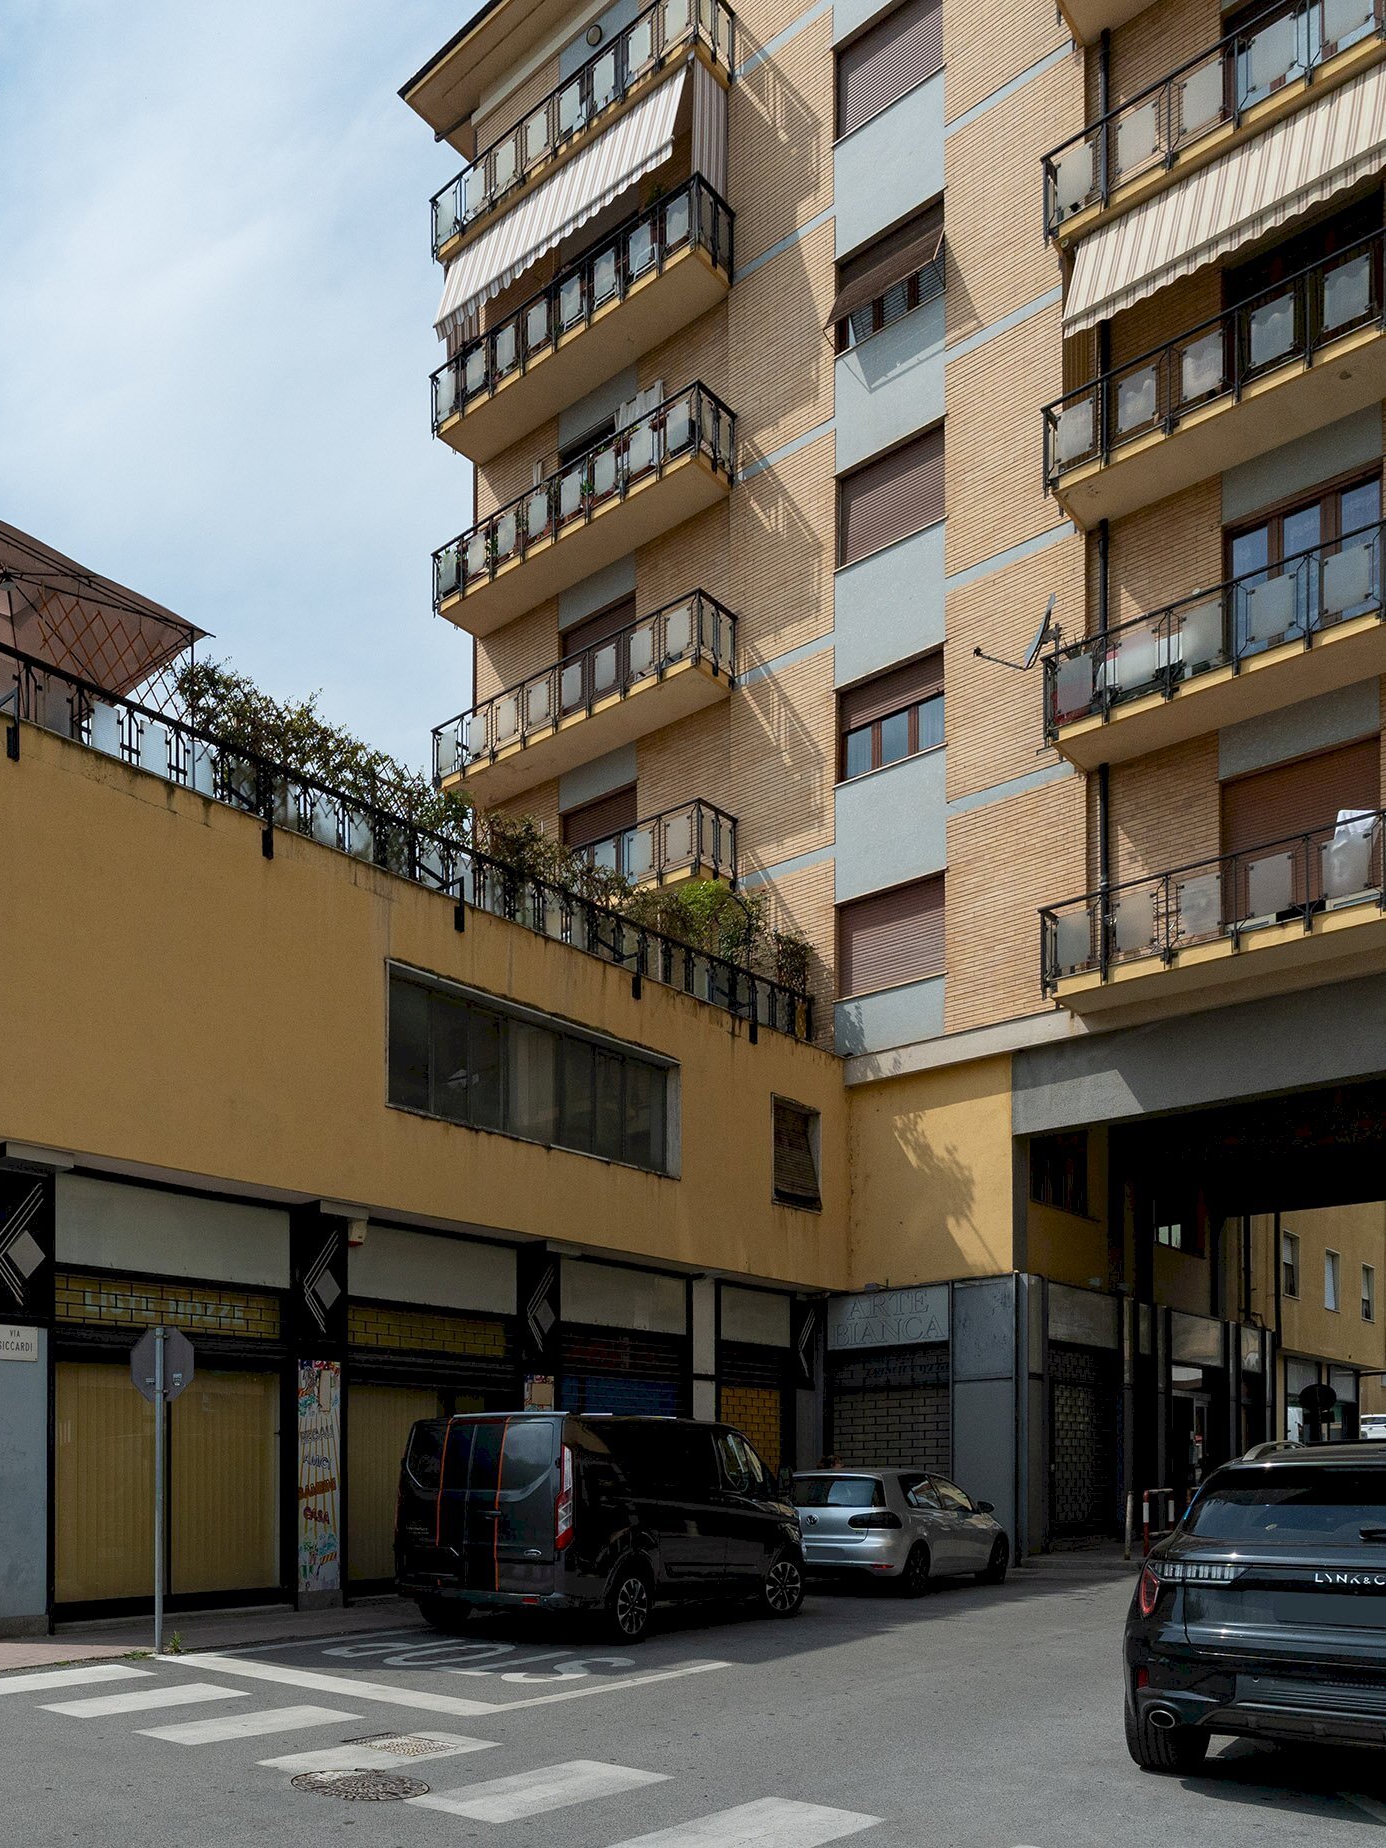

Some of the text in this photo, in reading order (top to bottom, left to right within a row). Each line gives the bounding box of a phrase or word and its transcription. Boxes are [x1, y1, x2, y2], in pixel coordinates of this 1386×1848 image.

[85, 1289, 155, 1317] LISTE
[846, 1289, 930, 1321] ARTE
[9, 1329, 21, 1338] VIA
[832, 1314, 946, 1347] BIANCA
[304, 1506, 330, 1524] CASA
